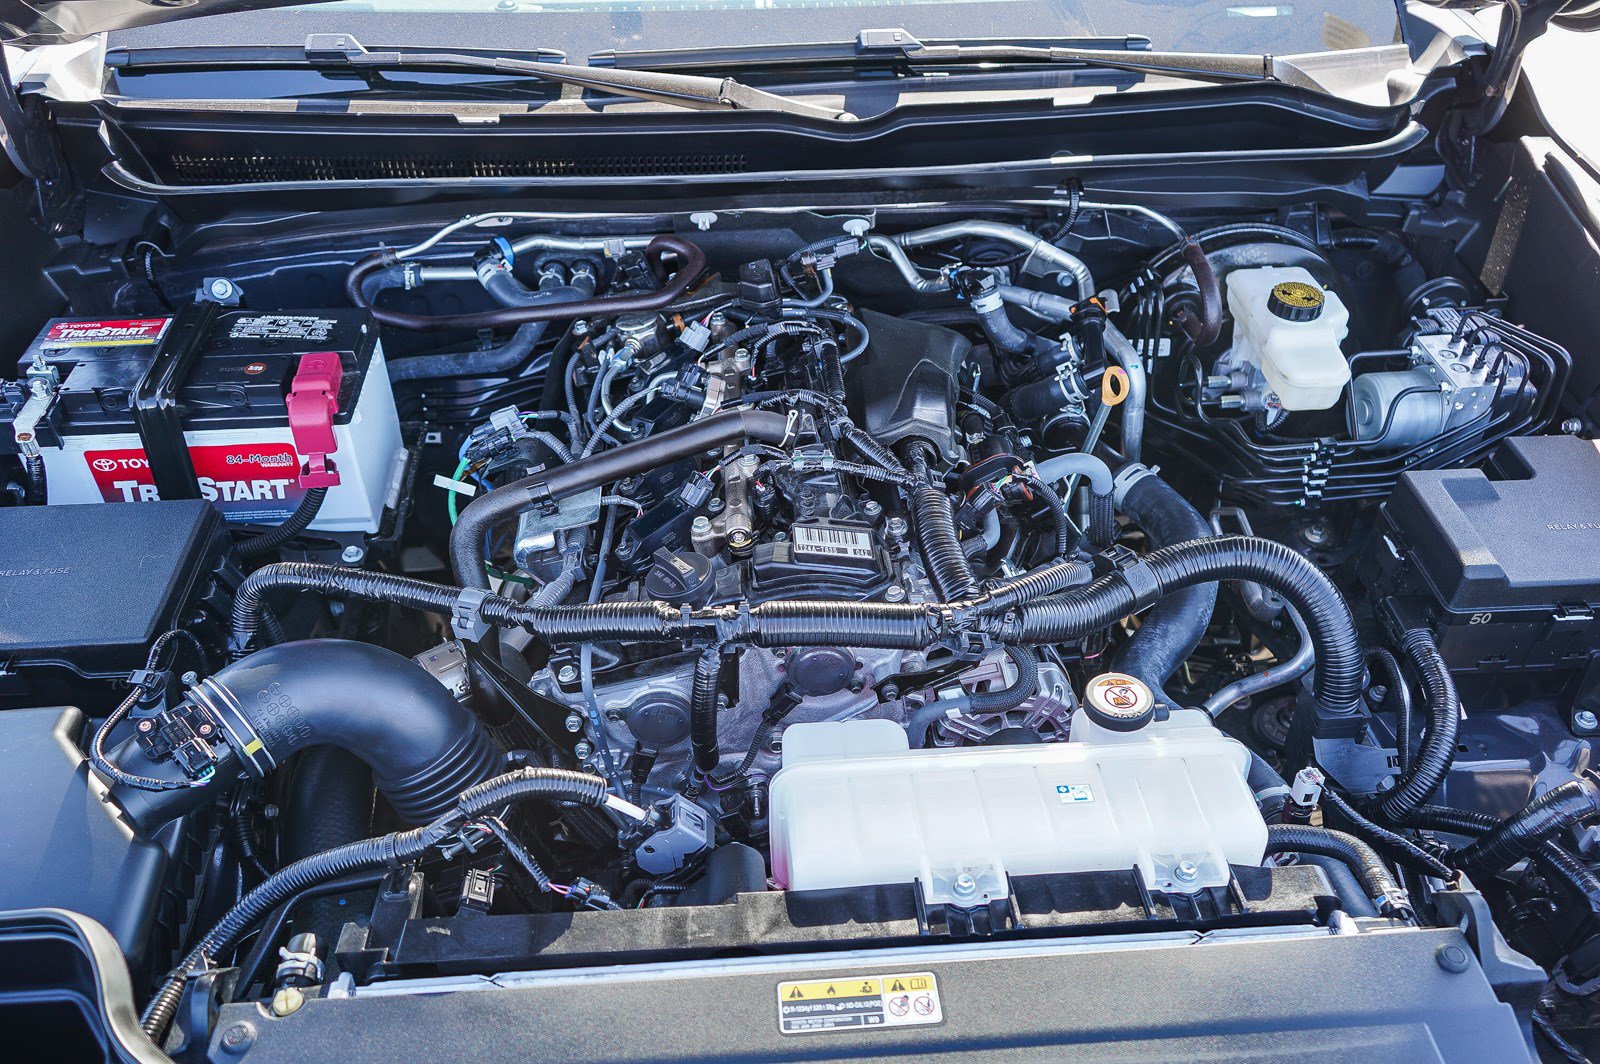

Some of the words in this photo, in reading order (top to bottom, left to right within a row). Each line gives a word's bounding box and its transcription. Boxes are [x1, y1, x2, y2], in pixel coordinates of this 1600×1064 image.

[118, 458, 150, 469] TOY
[226, 453, 293, 464] 84-Month
[43, 566, 71, 575] FUSE
[1469, 613, 1492, 625] 50
